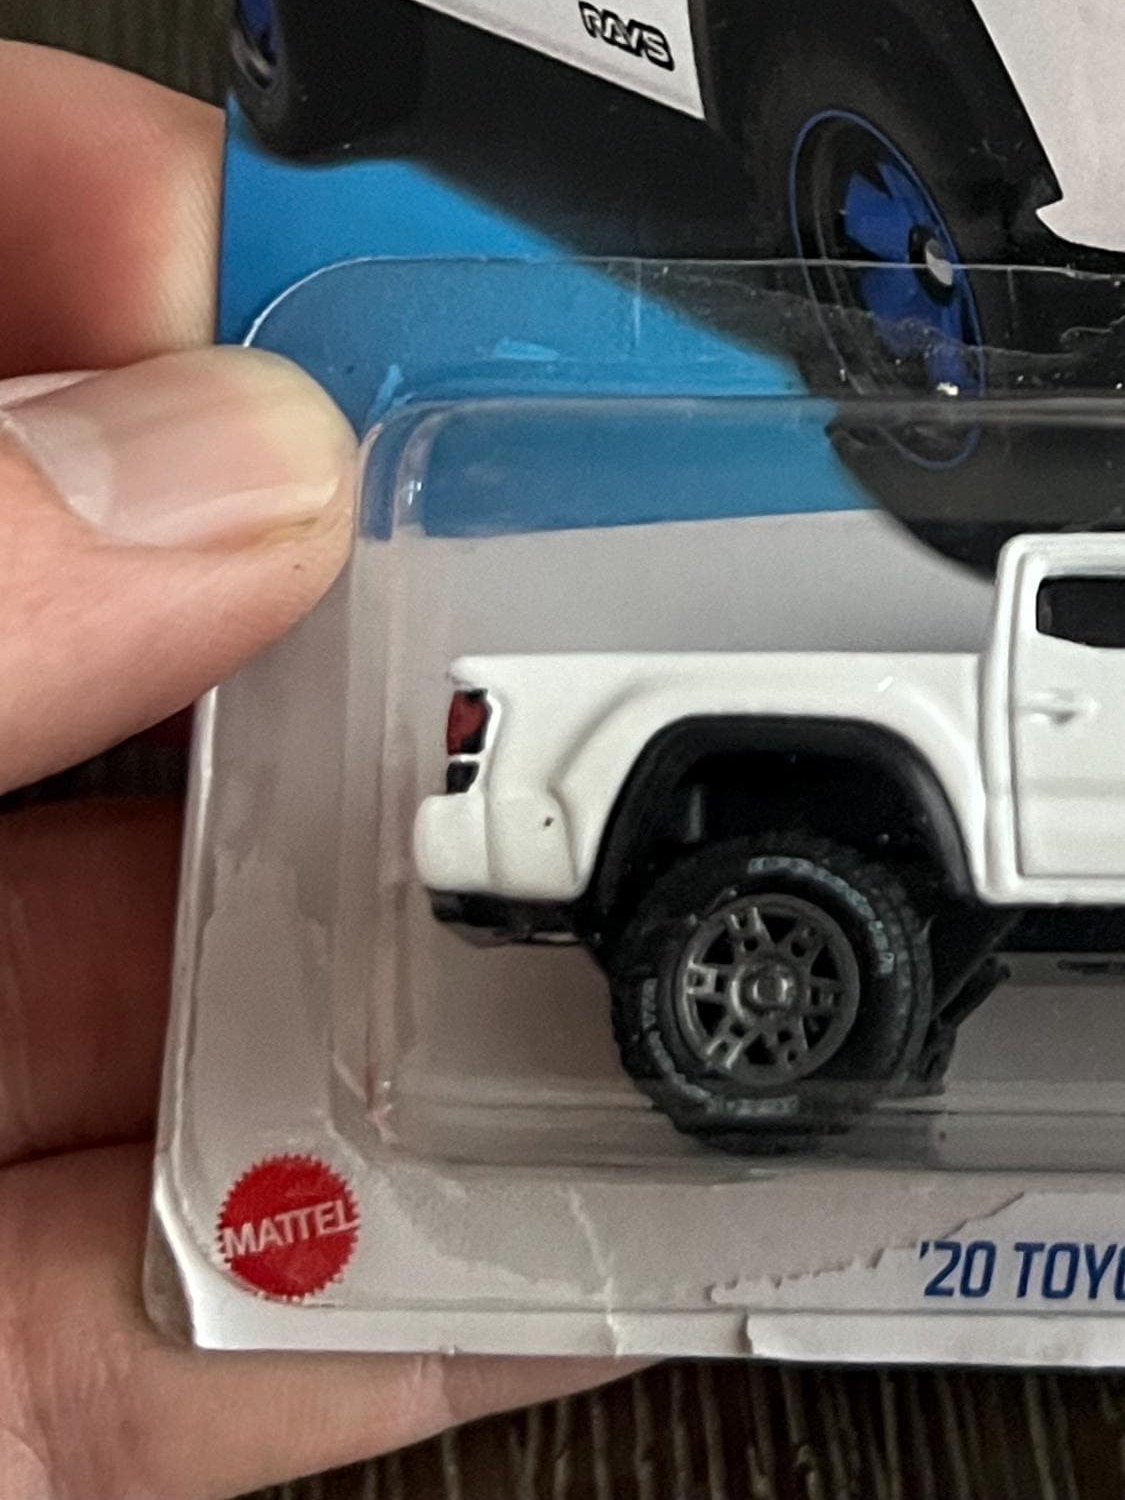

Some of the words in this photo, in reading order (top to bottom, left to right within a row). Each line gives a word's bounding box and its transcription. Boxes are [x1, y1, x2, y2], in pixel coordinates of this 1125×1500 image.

[578, 0, 675, 72] RAYS
[222, 1199, 361, 1259] MATTEL
[919, 1239, 996, 1299] '20
